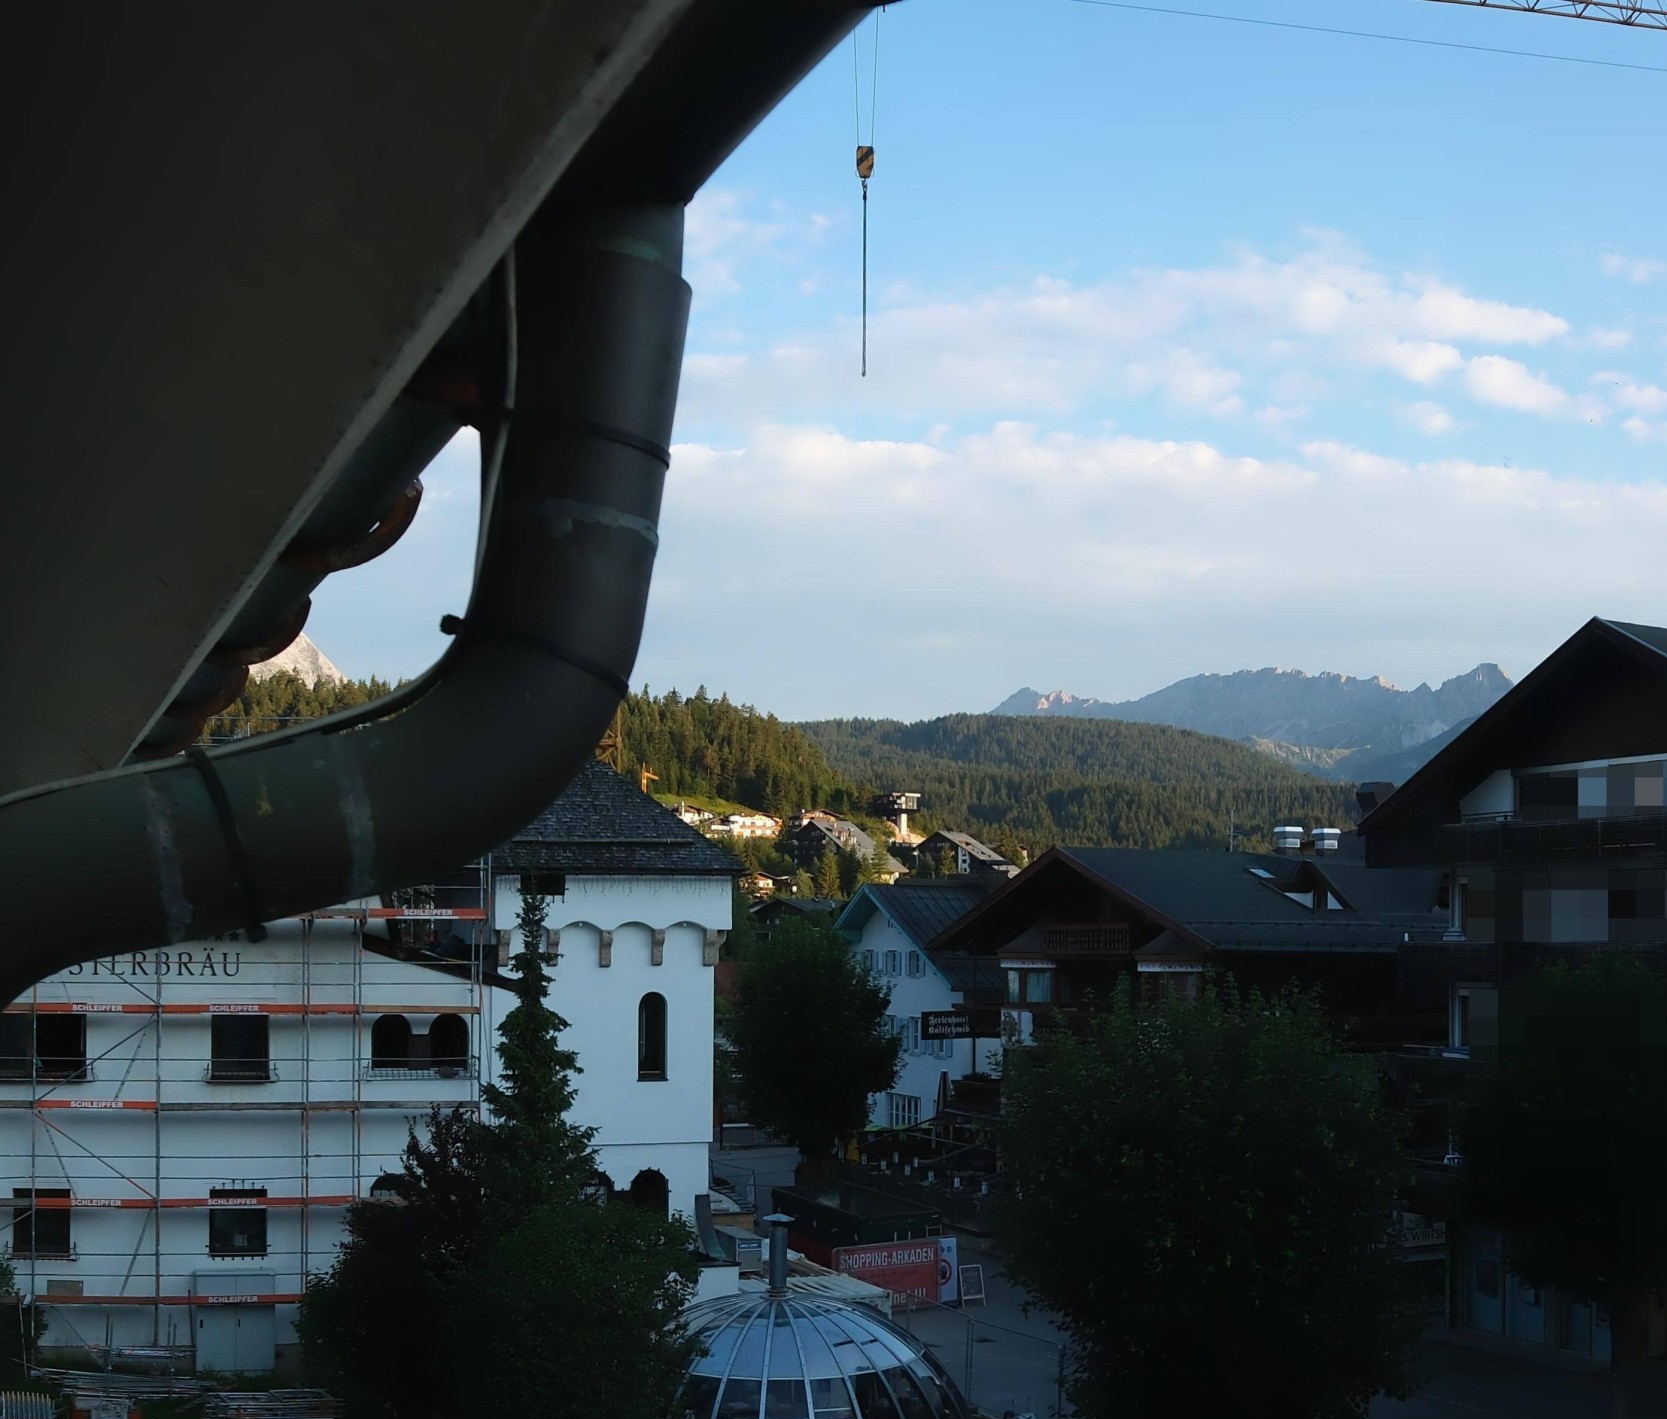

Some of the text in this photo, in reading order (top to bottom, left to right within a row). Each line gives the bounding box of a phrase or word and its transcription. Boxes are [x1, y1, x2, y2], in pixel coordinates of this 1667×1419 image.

[403, 908, 453, 916] SCHLEIPFER
[71, 1004, 123, 1012] SCHLEIPFER
[208, 1004, 260, 1012] SCHLEIPFER
[70, 1101, 124, 1109] SCHLEIPFER
[71, 1199, 122, 1207] SCHLEIPFER
[207, 1198, 257, 1206] SCHLEIPFER
[840, 1248, 935, 1270] SHOPPING-ARKADEN
